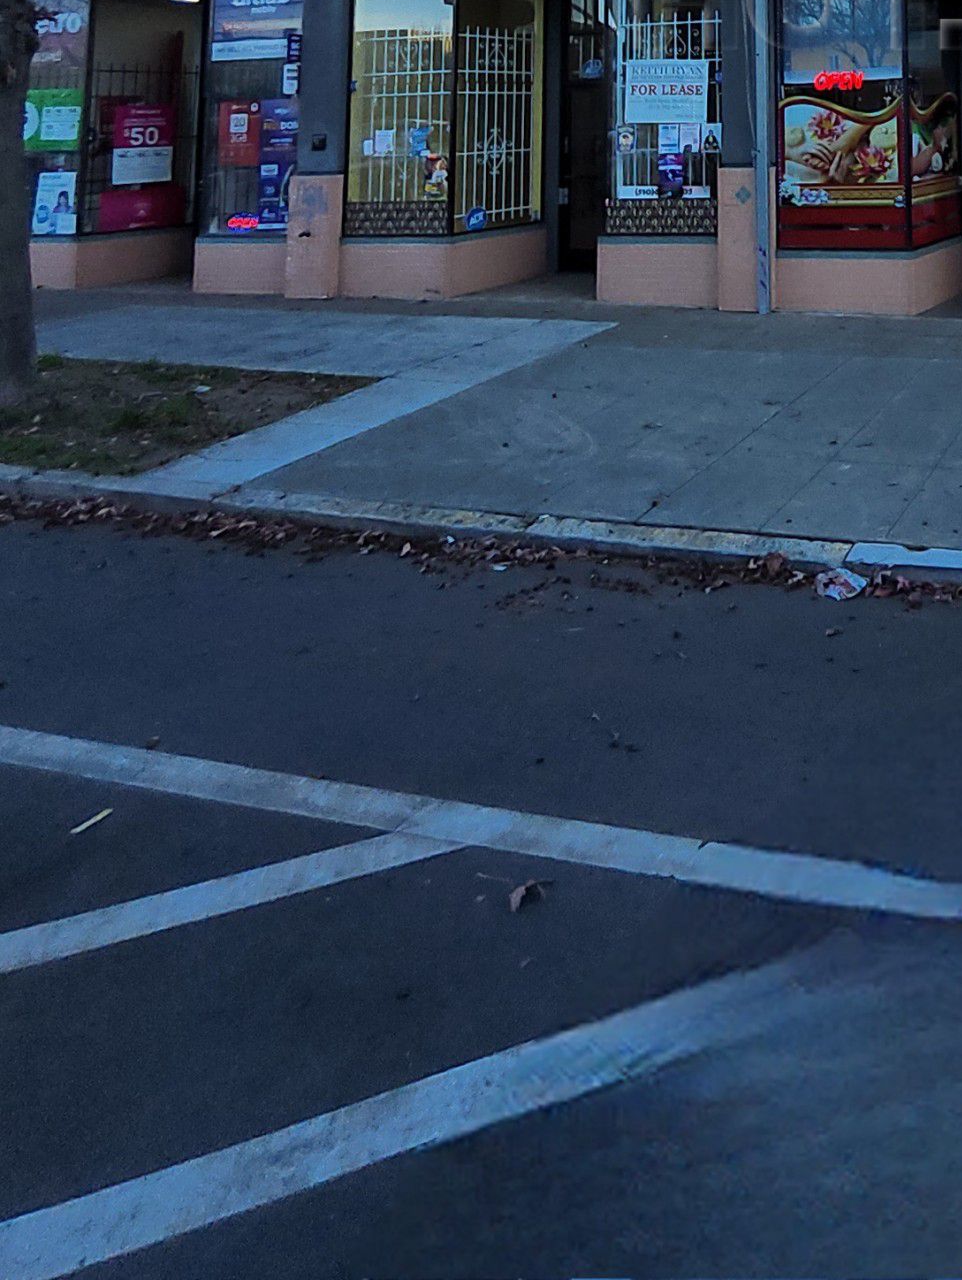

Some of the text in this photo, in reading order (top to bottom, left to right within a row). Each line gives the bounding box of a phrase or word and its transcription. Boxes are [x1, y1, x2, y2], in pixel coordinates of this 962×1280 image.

[631, 84, 704, 96] FOR LEASE
[813, 70, 865, 91] OPEN
[123, 126, 160, 147] $50
